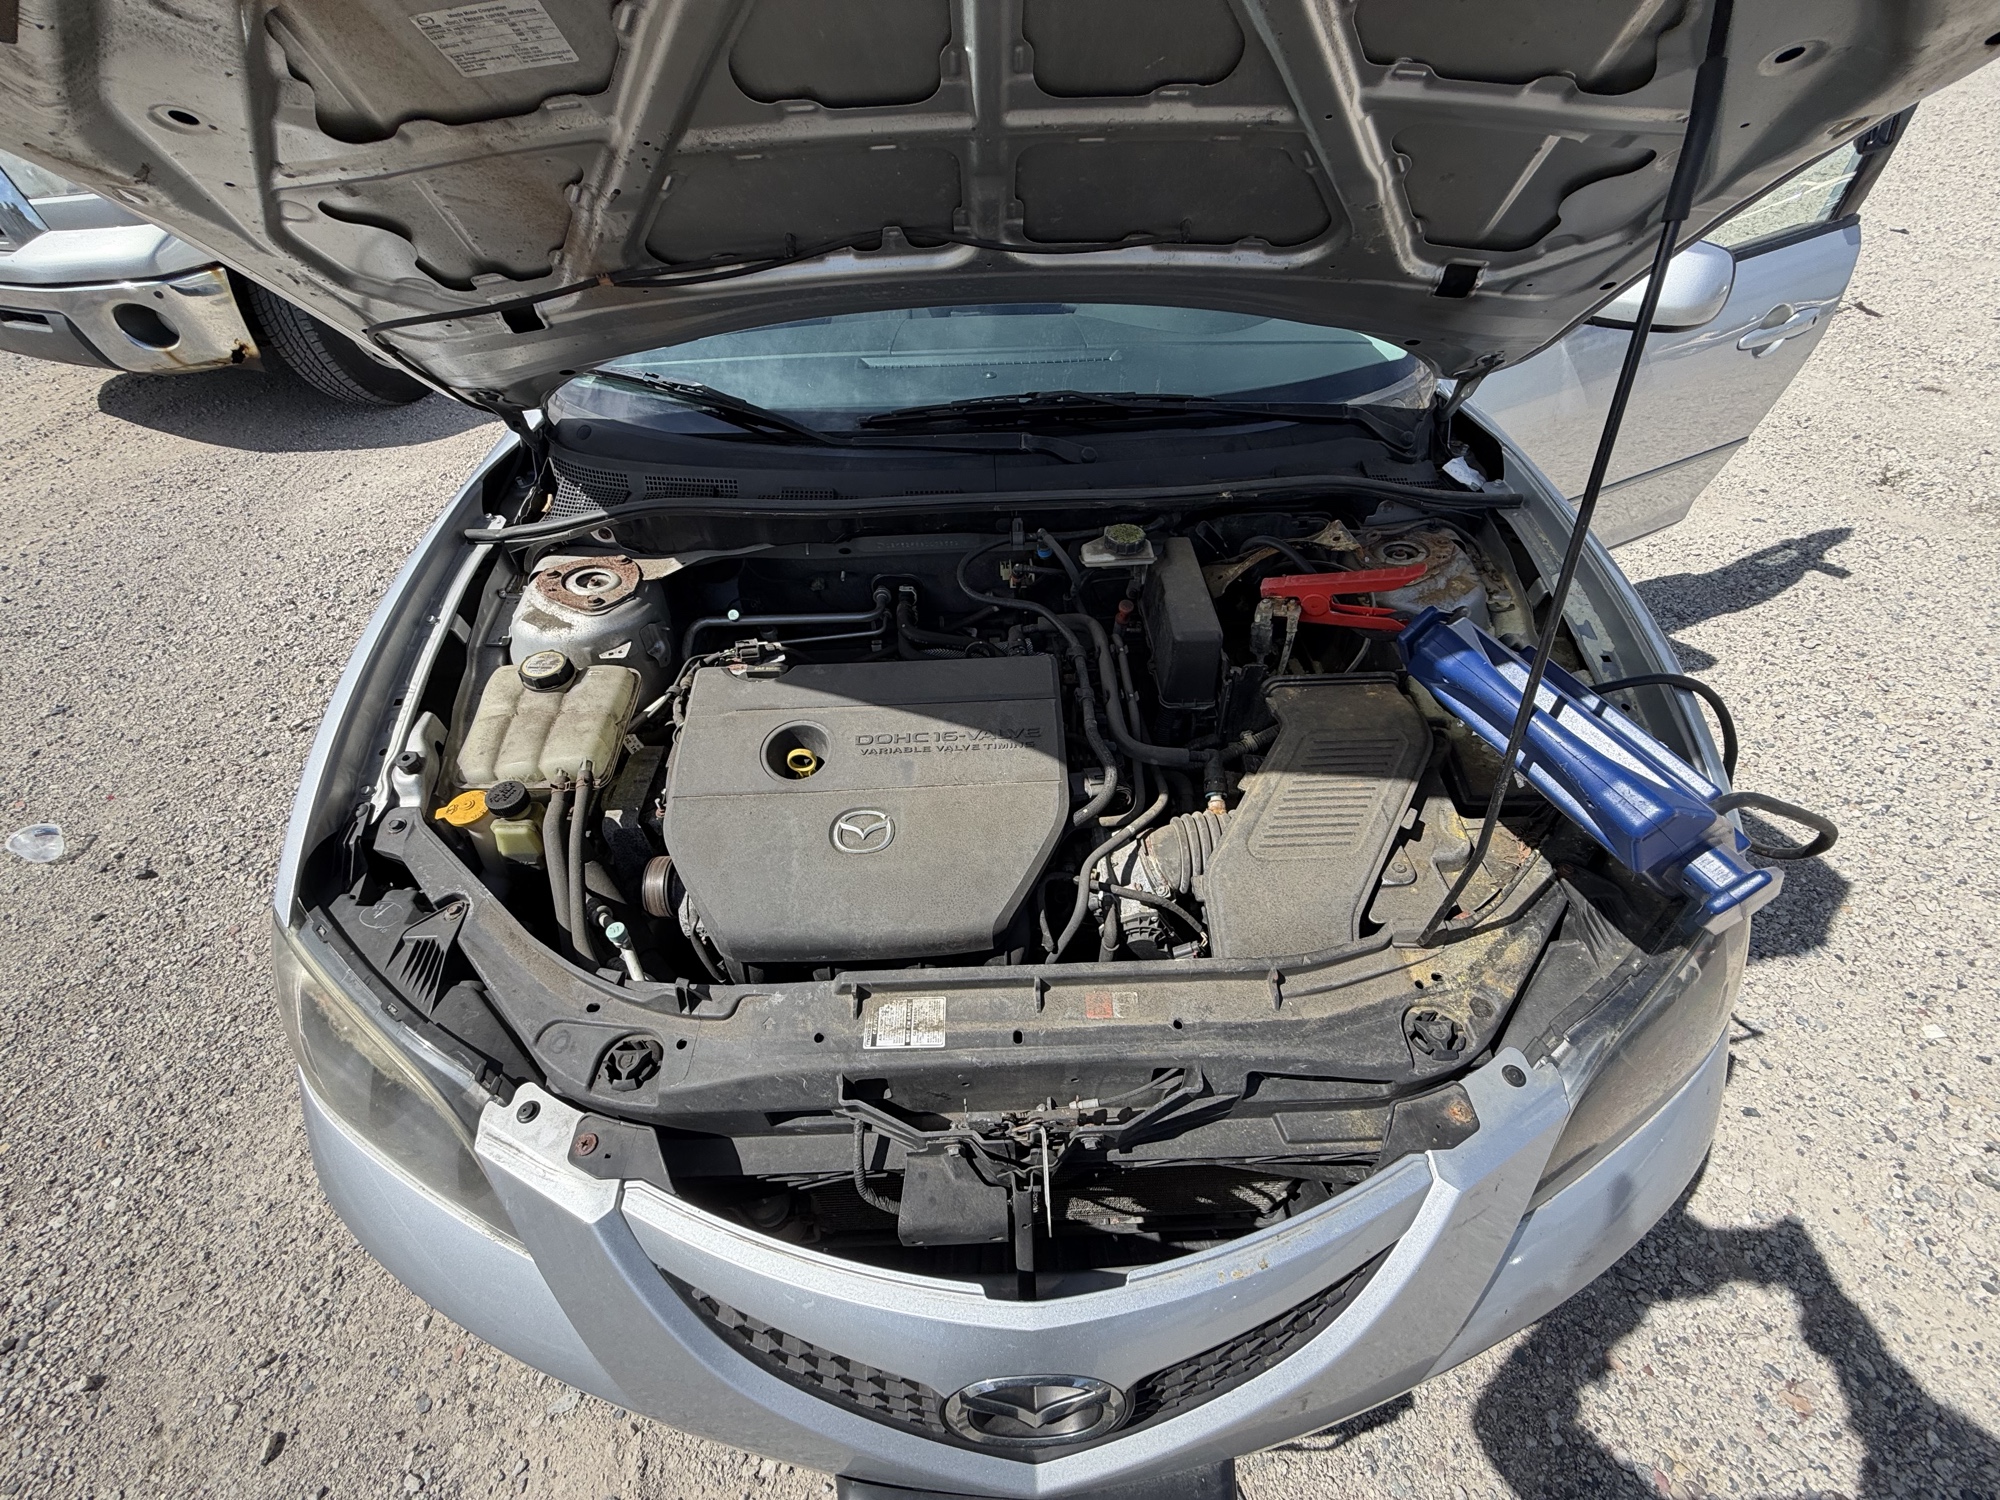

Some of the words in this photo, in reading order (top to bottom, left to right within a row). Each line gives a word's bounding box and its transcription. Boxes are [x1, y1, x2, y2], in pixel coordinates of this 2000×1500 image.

[855, 732, 929, 746] DOHC
[933, 727, 1041, 742] 16-VALVE
[860, 745, 931, 756] VARIABLE
[936, 743, 980, 752] VALVE
[983, 741, 1035, 750] TIMING
